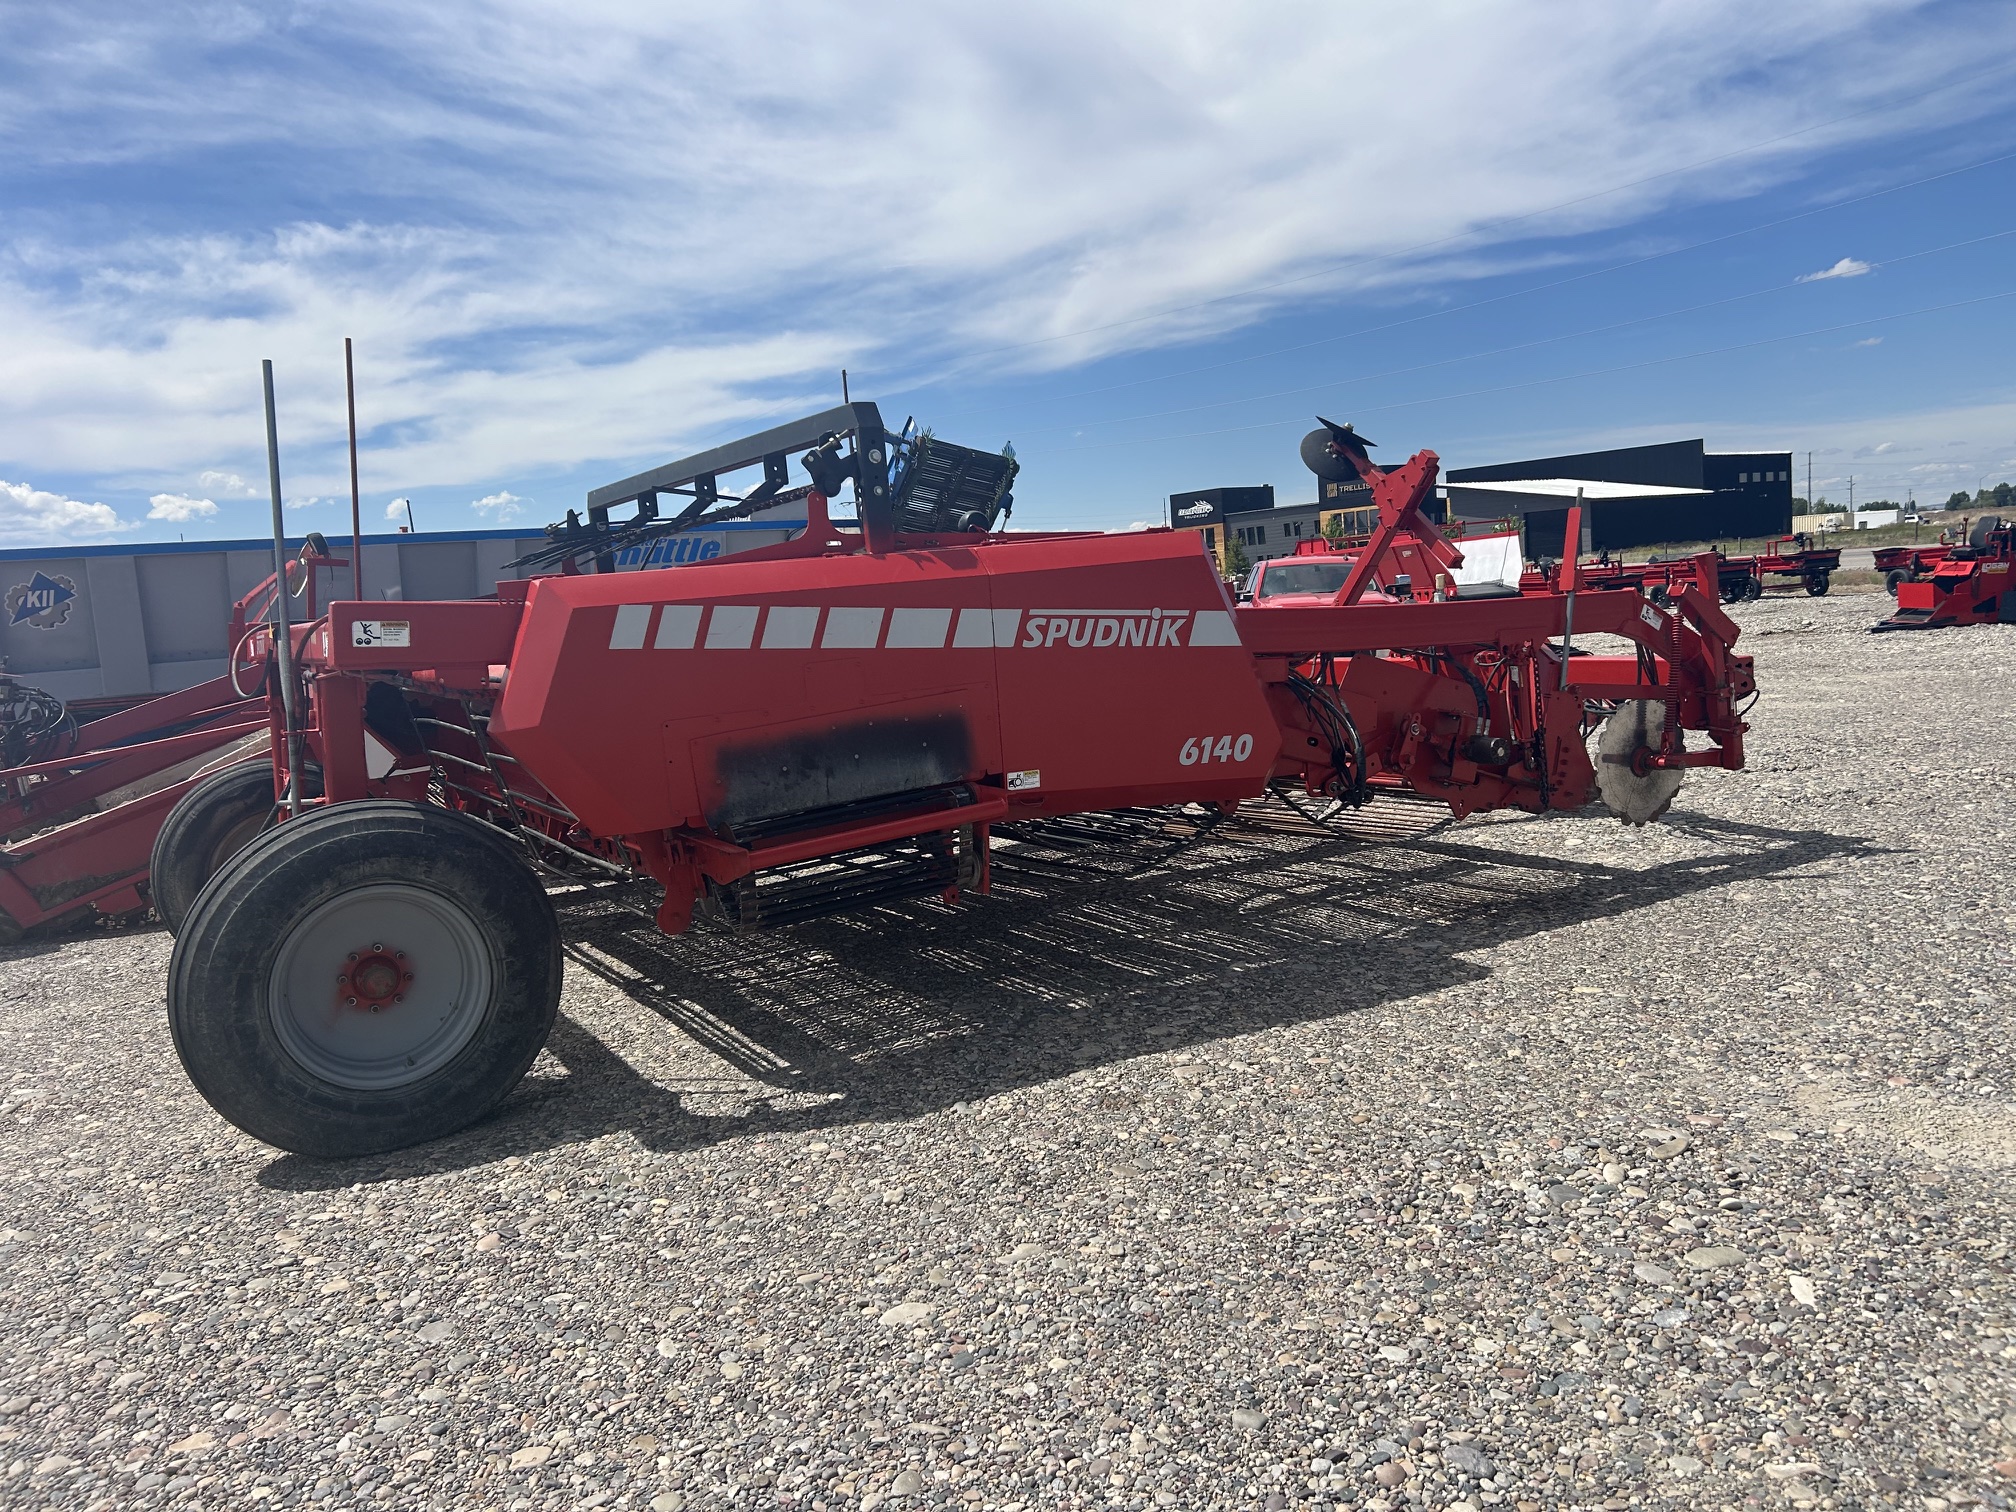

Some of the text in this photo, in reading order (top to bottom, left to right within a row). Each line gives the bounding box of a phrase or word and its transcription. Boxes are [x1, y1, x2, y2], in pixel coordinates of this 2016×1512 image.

[1339, 483, 1371, 492] TRELLIS
[1981, 562, 2010, 573] LOGAN
[26, 590, 55, 608] KII
[1179, 733, 1254, 766] 6140
